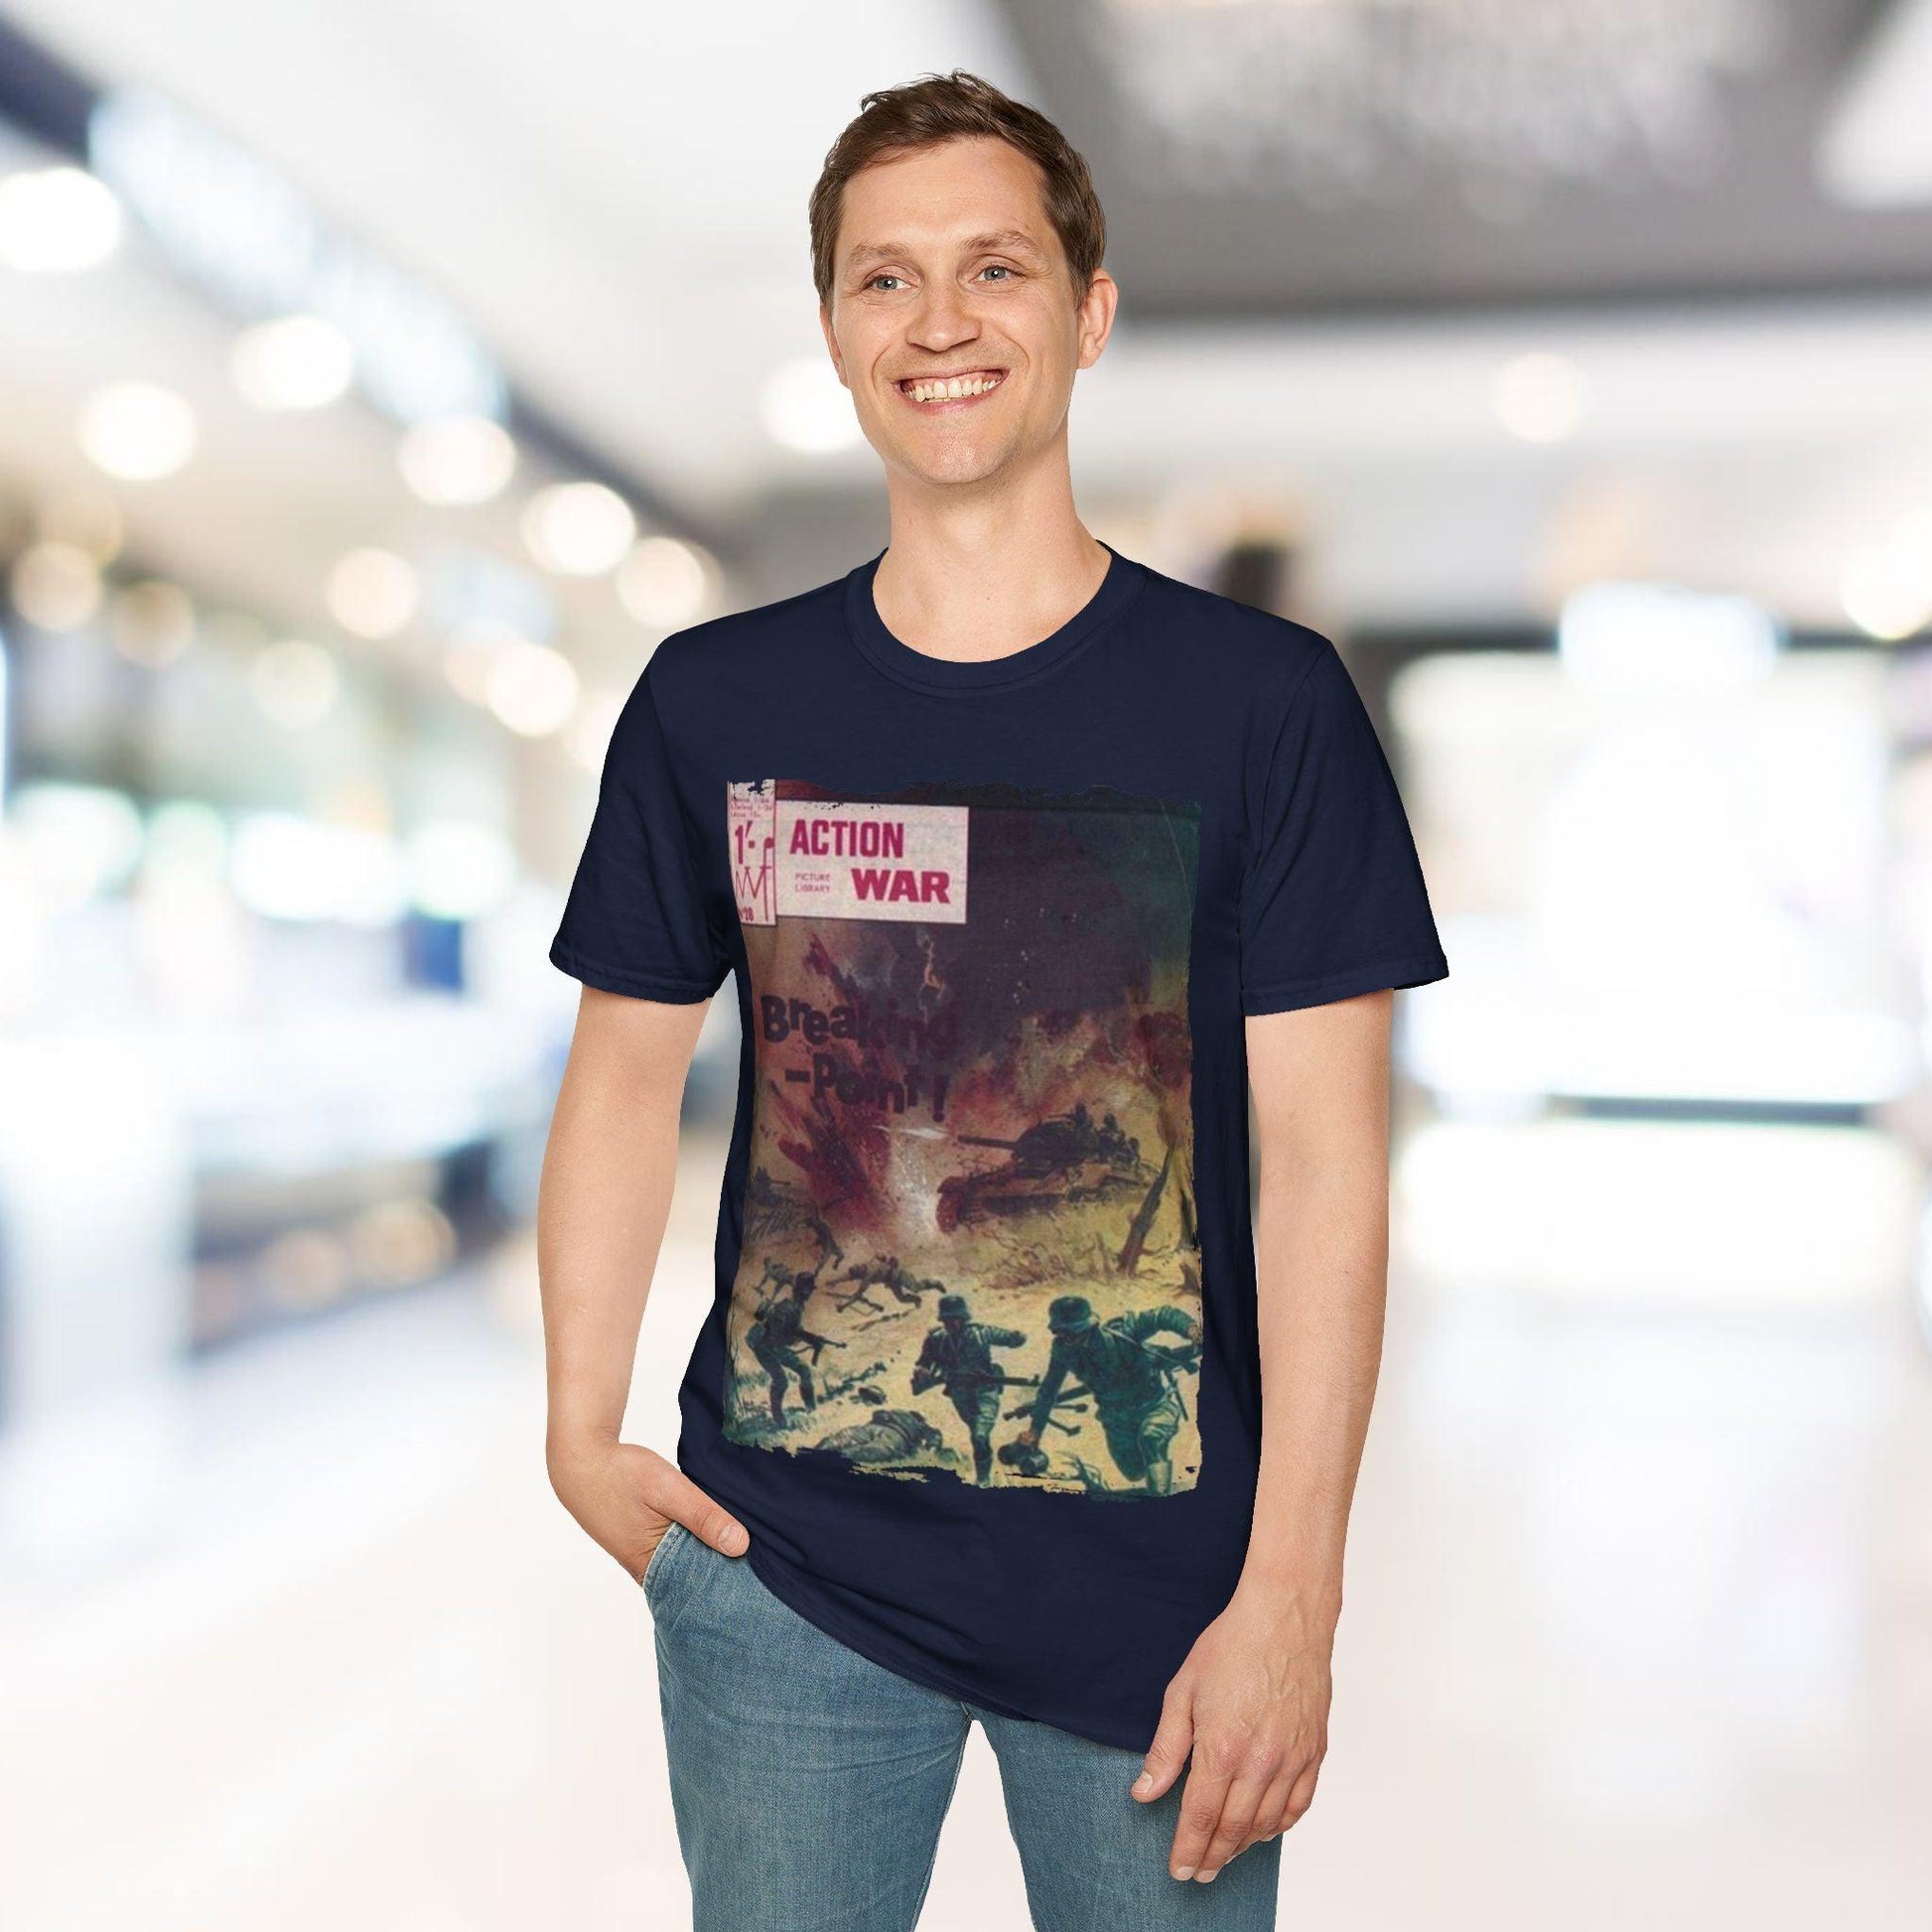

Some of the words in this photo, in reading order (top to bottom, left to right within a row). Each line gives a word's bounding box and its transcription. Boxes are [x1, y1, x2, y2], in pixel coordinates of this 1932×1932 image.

[789, 819, 904, 859] ACTION
[794, 873, 831, 884] PICTURE
[794, 884, 831, 894] LIBRARY
[851, 868, 950, 904] WAR
[760, 995, 958, 1060] Breaking
